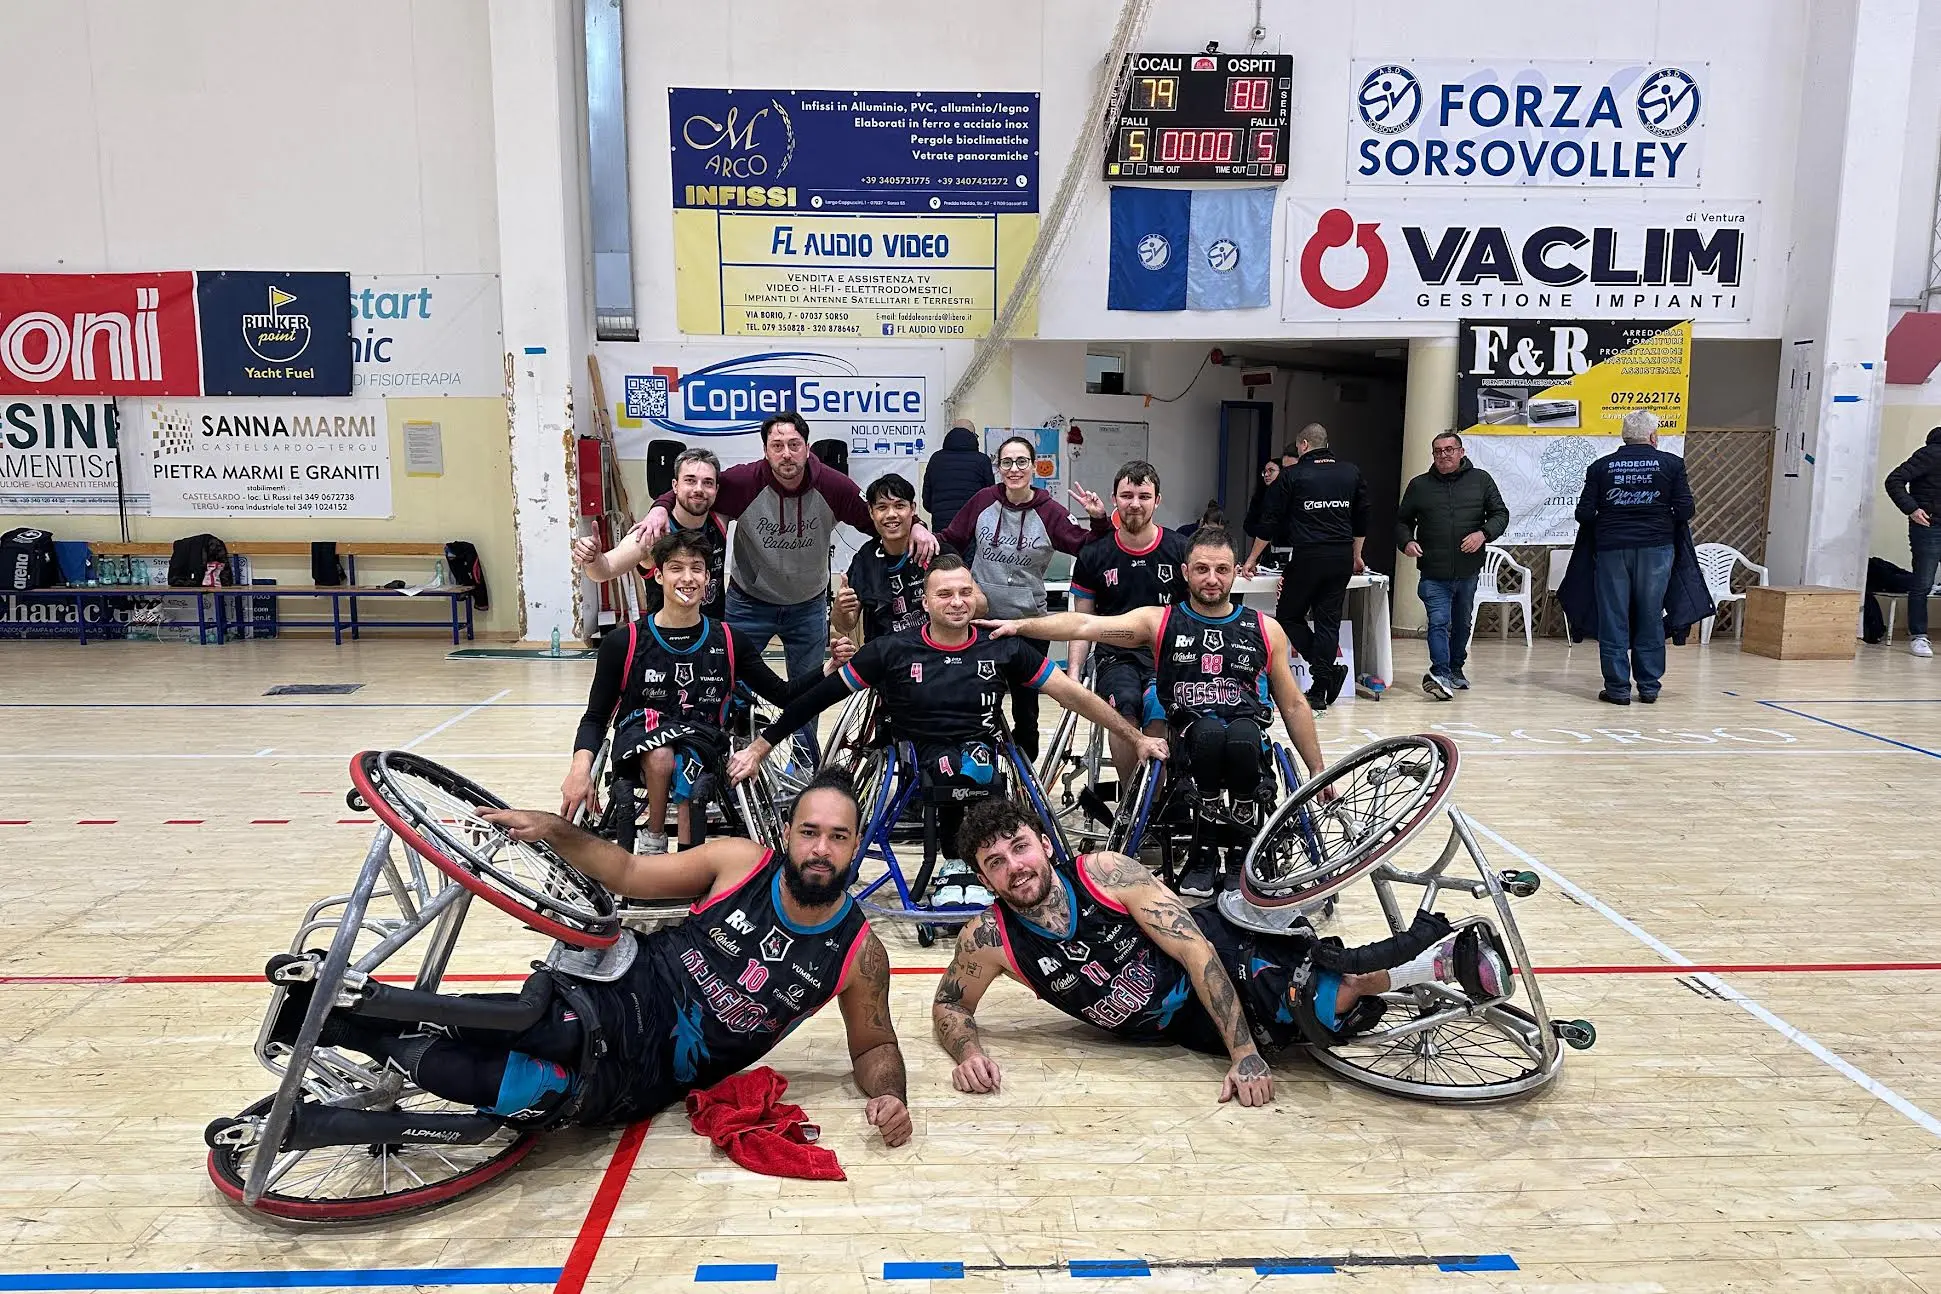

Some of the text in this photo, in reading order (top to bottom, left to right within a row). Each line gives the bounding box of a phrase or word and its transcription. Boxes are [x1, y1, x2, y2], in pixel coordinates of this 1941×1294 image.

[1131, 58, 1182, 72] LOCALI
[1227, 58, 1276, 72] OSPITI
[1141, 79, 1175, 108] 79
[1233, 79, 1269, 110] 80
[801, 100, 1030, 115] Infissi in Alluminio, PVC, alluminio/legno
[1439, 84, 1622, 129] FORZA
[854, 118, 1029, 129] Elaborati in ferro e acciaio inox
[1121, 117, 1148, 126] FALLI
[1250, 118, 1278, 127] FALLI
[911, 134, 1029, 147] Pergole bioclimatiche
[1129, 131, 1146, 161] 5
[1257, 132, 1274, 161] 5
[912, 150, 1029, 163] Vetrate panoramiche
[1358, 138, 1688, 179] SORSOVOLLEY
[705, 154, 768, 179] ARCO
[1149, 166, 1181, 174] TIME OUT
[1215, 166, 1247, 174] TIME OUT
[861, 176, 931, 185] +39 3405731775
[937, 177, 1009, 186] +39 3407421272
[685, 185, 797, 207] INFISSI
[1685, 213, 1745, 223] di Ventura
[772, 226, 949, 258] FL AUDIO VIDEO
[1401, 226, 1745, 287] VACLIM
[788, 273, 931, 284] VENDITA E ASSISTENZA TV
[766, 283, 952, 295] VIDEO HI-FI ELETTRODOMESTICI
[744, 293, 786, 303] IMPIANTI
[802, 295, 848, 304] ANTENNE
[851, 295, 910, 305] SATELLITARI
[923, 296, 974, 305] TERRESTRI
[1416, 293, 1738, 309] GESTIONE IMPIANTI
[746, 310, 849, 321] VIA BORIO, 7 07037 SORSO
[243, 315, 310, 330] BUNKER
[746, 323, 860, 333] TEL. 079 350828 320 8786467
[0, 288, 163, 383] oni
[897, 325, 965, 334] FL AUDIO VIDEO
[1622, 329, 1684, 337] ARREDO BAR
[257, 327, 297, 347] point
[1626, 337, 1684, 346] FORNITURE
[1599, 347, 1683, 356] PROGETTAZIONE
[1603, 356, 1683, 365] INSTALLAZIONE
[244, 366, 315, 380] Yacht Fuel
[1621, 367, 1682, 375] ASSISTENZA
[370, 372, 462, 387] FISIOTERAPIA
[687, 379, 922, 419] Copier Service
[1611, 392, 1681, 404] 079 262176
[851, 425, 926, 436] NOLO VENDITA
[1608, 460, 1660, 468] SARDEGNA
[153, 464, 380, 480] PIETRA MARMI E GRANITI
[37, 481, 86, 489] ISOLAMENTI
[246, 484, 286, 492] stabilimenti
[182, 492, 355, 501] CASTELSARDO loc. Li Russi tel 349 0672738
[192, 502, 219, 511] TERGU
[246, 503, 285, 511] industriale
[286, 503, 296, 511] tel
[297, 503, 313, 511] 349
[314, 503, 348, 511] 1024152
[1313, 500, 1350, 509] GIVOVA
[762, 536, 814, 550] Calabria
[1201, 653, 1223, 675] 88
[737, 958, 769, 993] 10
[791, 962, 822, 990] VUMBACA
[1080, 960, 1111, 987] 11
